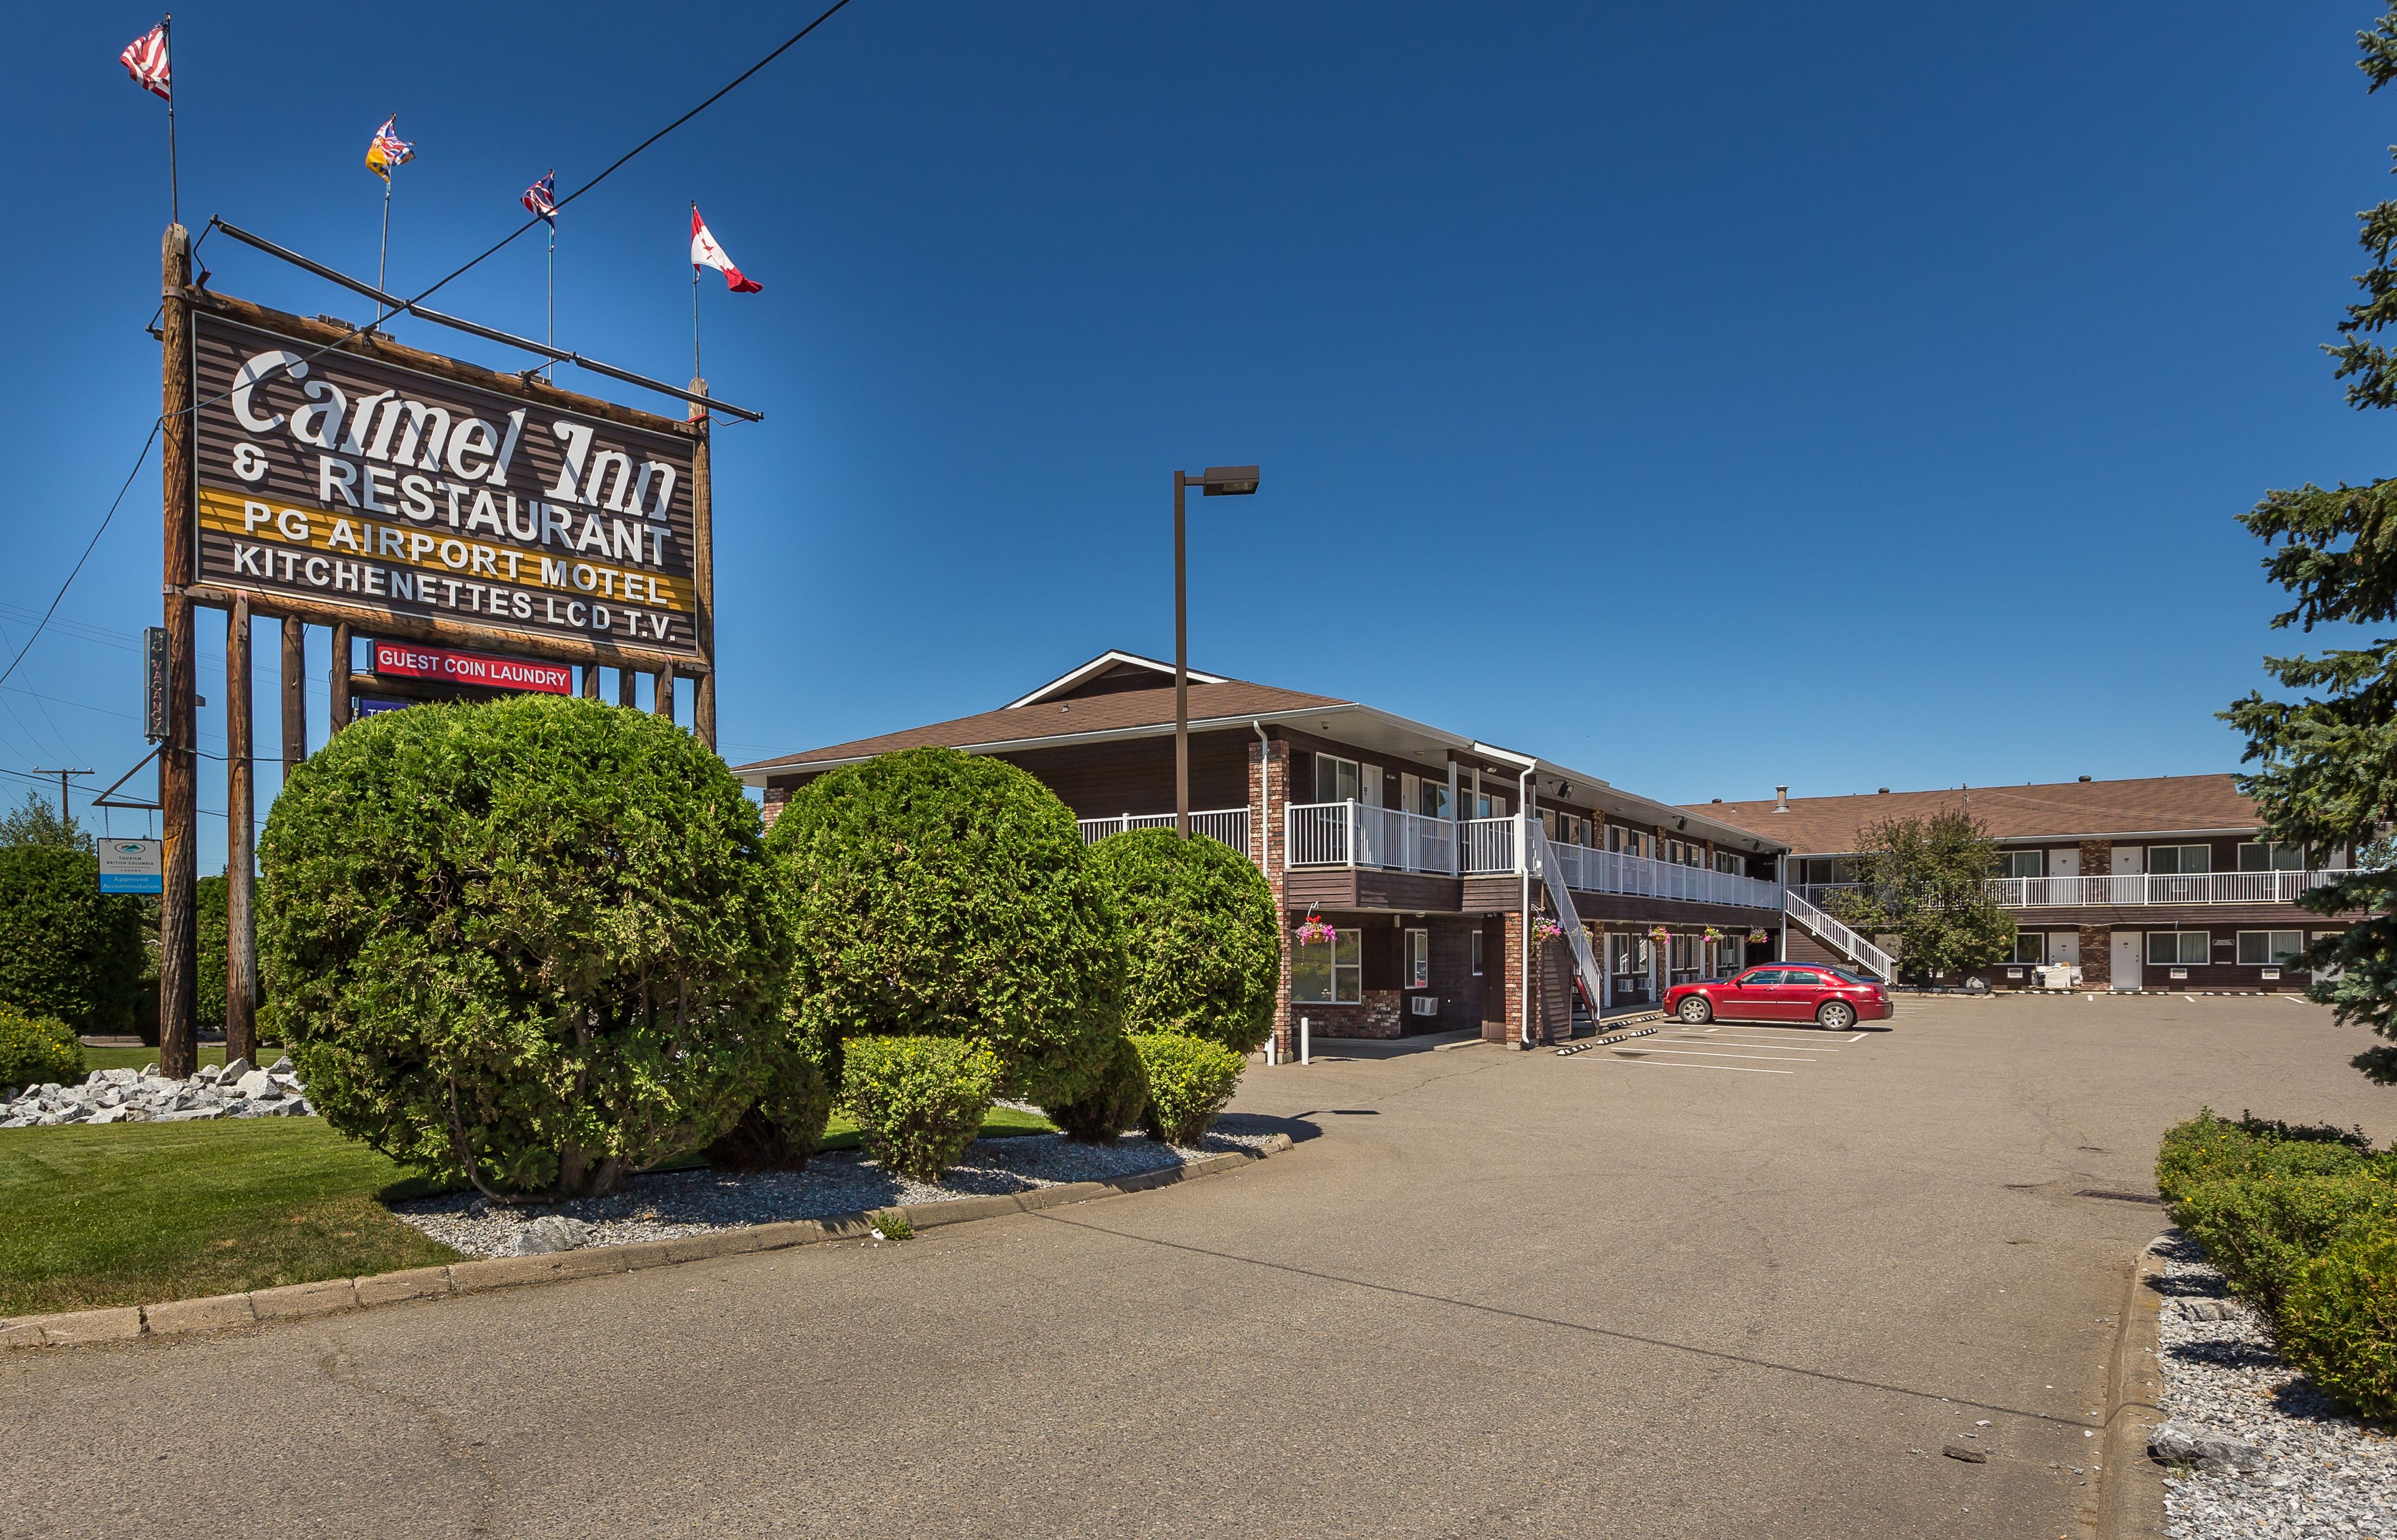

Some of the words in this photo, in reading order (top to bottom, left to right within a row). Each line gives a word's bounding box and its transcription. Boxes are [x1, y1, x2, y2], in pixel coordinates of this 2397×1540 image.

[232, 350, 526, 487] Carmel
[544, 419, 676, 521] Inn
[233, 443, 269, 481] &
[320, 455, 671, 566] RESTAURANT
[245, 501, 309, 541] PG
[327, 519, 524, 579] AIRPORT
[541, 557, 667, 604] MOTEL
[234, 543, 531, 618] KITCHENETTES
[547, 597, 610, 630] LCD
[624, 610, 675, 641] T.V.
[150, 659, 162, 730] VACANCY
[380, 650, 439, 671] GUEST
[444, 658, 486, 677] COIN
[491, 664, 567, 687] LAUNDRY
